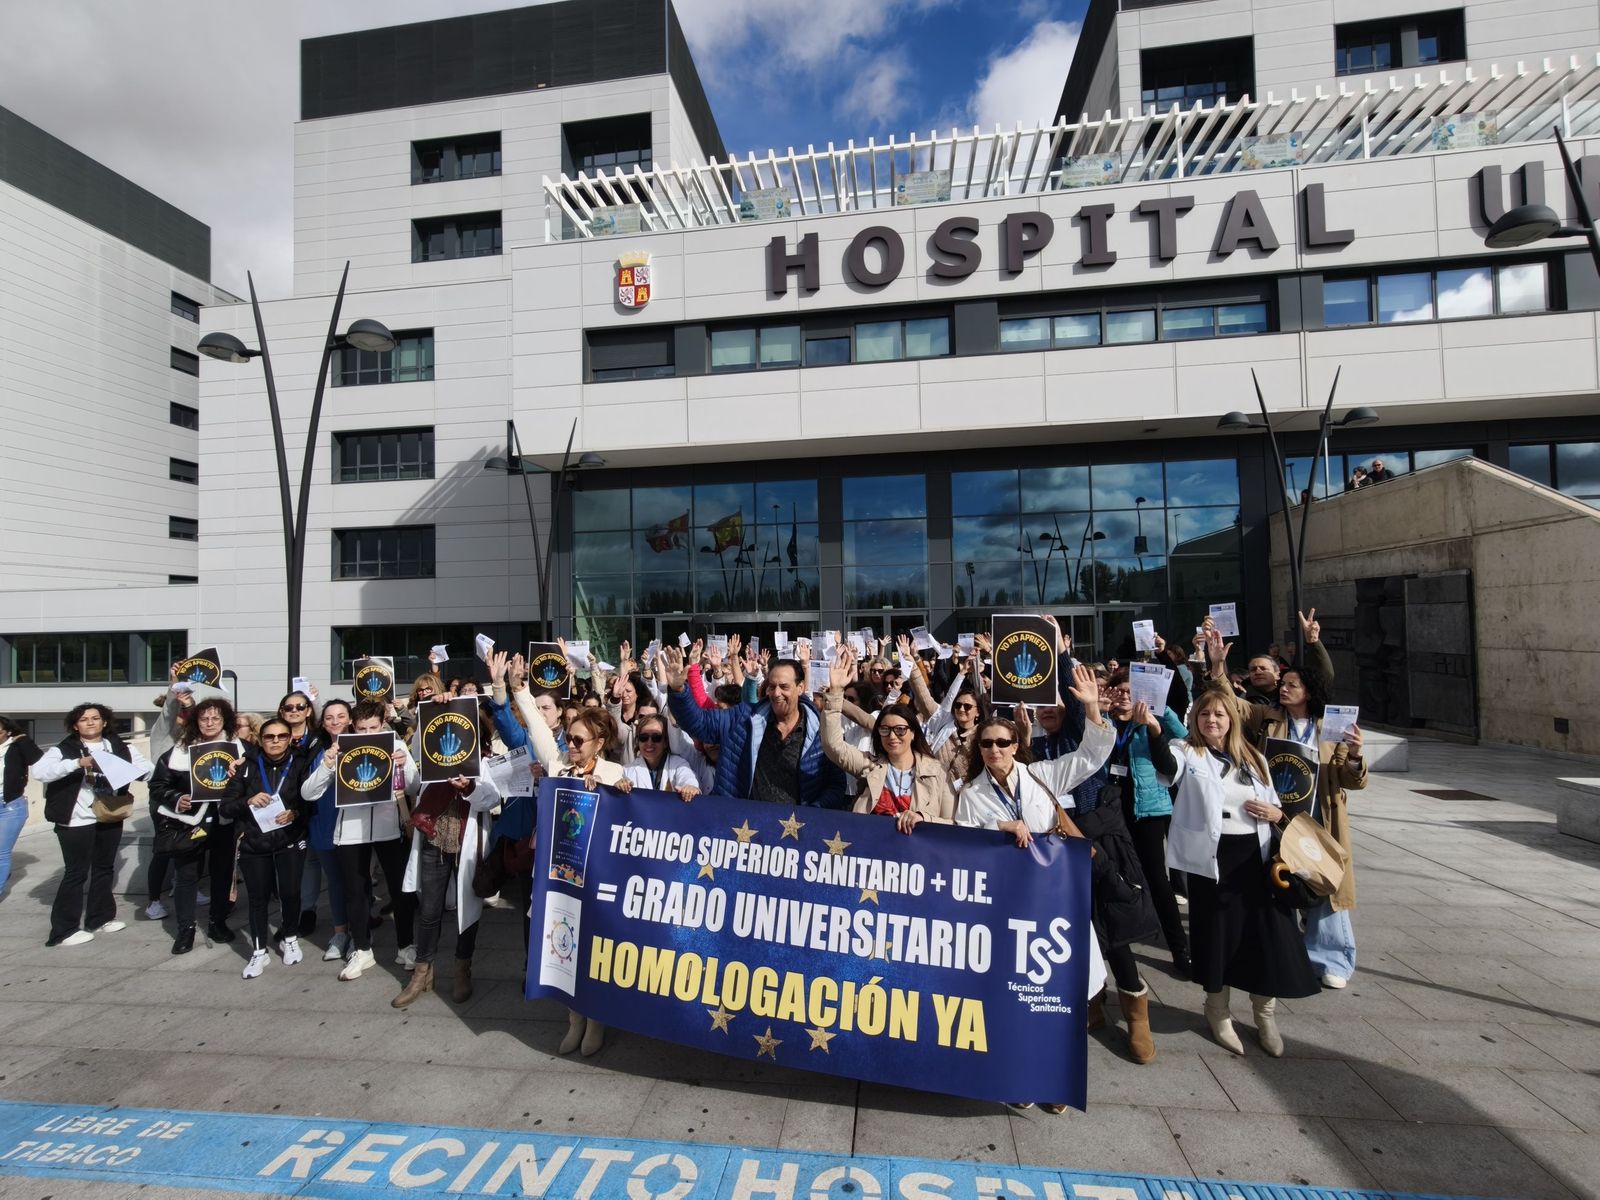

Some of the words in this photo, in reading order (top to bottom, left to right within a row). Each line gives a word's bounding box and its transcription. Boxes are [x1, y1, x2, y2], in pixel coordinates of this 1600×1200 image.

[770, 184, 1354, 295] HOSPITAL
[1000, 642, 1010, 651] YO
[1008, 635, 1018, 645] NO
[1020, 634, 1047, 651] APRIETO
[1005, 672, 1043, 684] BOTONES
[428, 724, 436, 734] YO
[434, 718, 444, 726] NO
[444, 715, 470, 730] APRIETO
[213, 752, 232, 764] APRIET
[344, 755, 352, 763] YO
[361, 748, 386, 760] APRIETO
[432, 750, 467, 762] BOTONES
[1274, 756, 1284, 764] NO
[1284, 756, 1310, 776] APRIETO
[348, 776, 382, 788] BOTONES
[1277, 791, 1300, 800] ONES
[609, 821, 694, 864] TÉCNICO
[697, 836, 800, 880] SUPERIOR
[804, 852, 925, 896] SANITARIO
[930, 872, 947, 892] +
[952, 868, 992, 904] U.E.
[596, 882, 618, 902] =
[622, 874, 726, 933] GRADO
[732, 891, 992, 974] UNIVERSITARIO
[1008, 917, 1072, 985] TSS
[588, 935, 920, 1042] HOMOLOGACIÓN
[932, 992, 989, 1053] YA
[1008, 981, 1044, 993] Técnicos
[1018, 992, 1061, 1004] Superiores
[1030, 1003, 1072, 1014] Sanitarios
[33, 1114, 140, 1136] LIBRE
[136, 1120, 195, 1140] DE
[0, 1140, 142, 1166] TABACO
[255, 1128, 698, 1200] RECINTO
